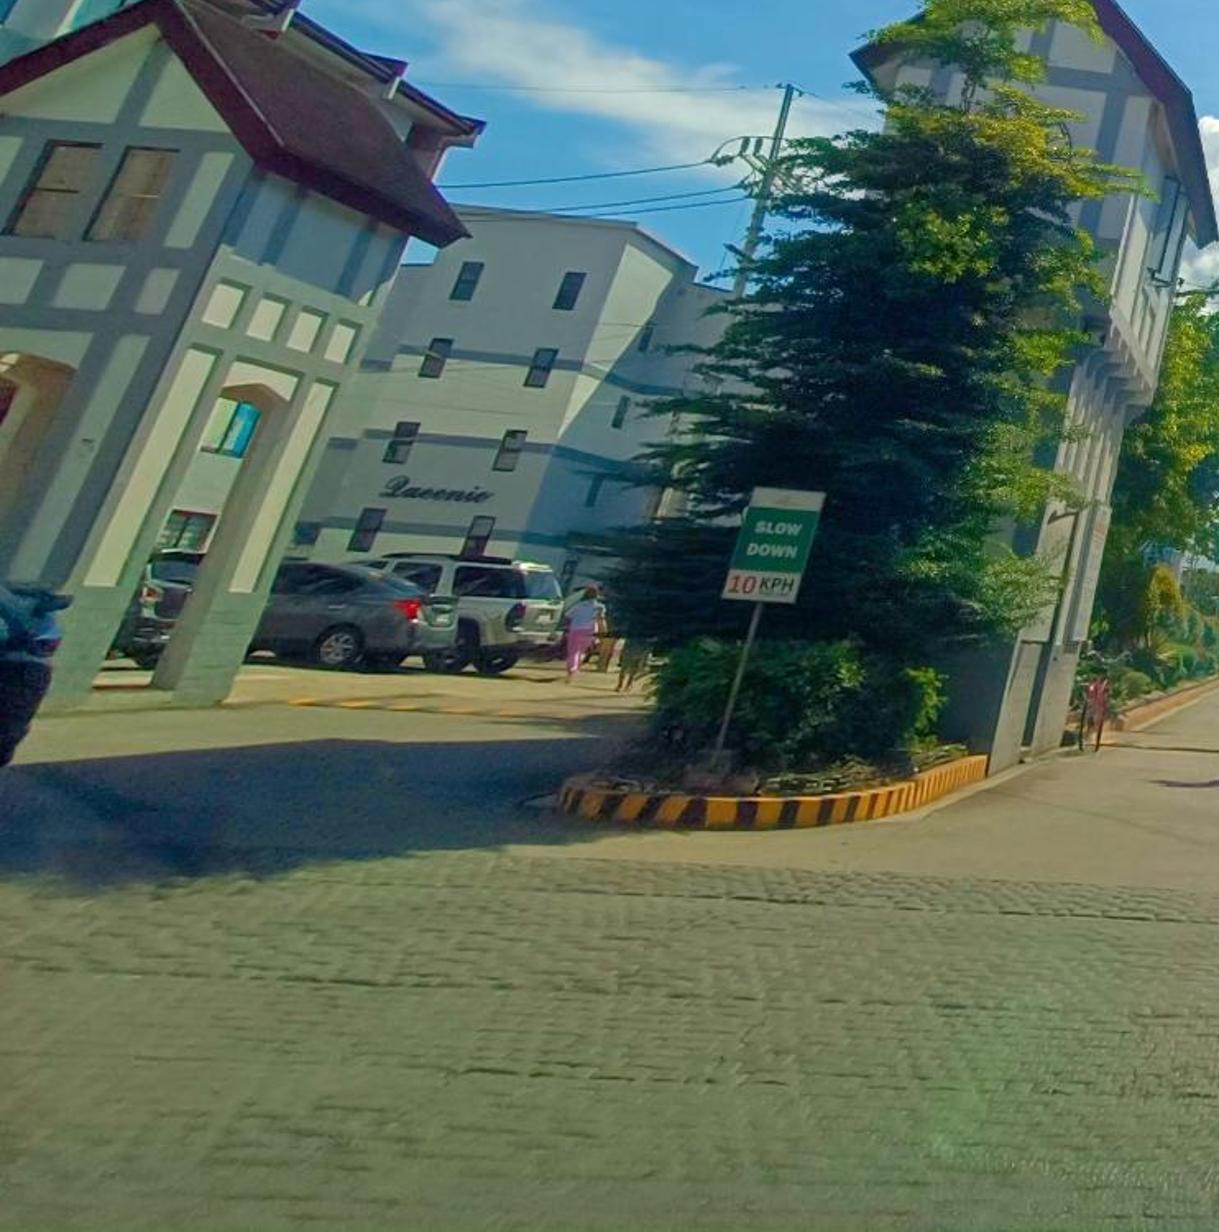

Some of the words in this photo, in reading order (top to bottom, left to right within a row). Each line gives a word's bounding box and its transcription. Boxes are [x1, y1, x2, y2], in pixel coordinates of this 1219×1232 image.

[754, 520, 803, 536] SLOW
[746, 542, 798, 558] DOWN
[728, 575, 757, 594] 10
[759, 577, 795, 593] KPH
